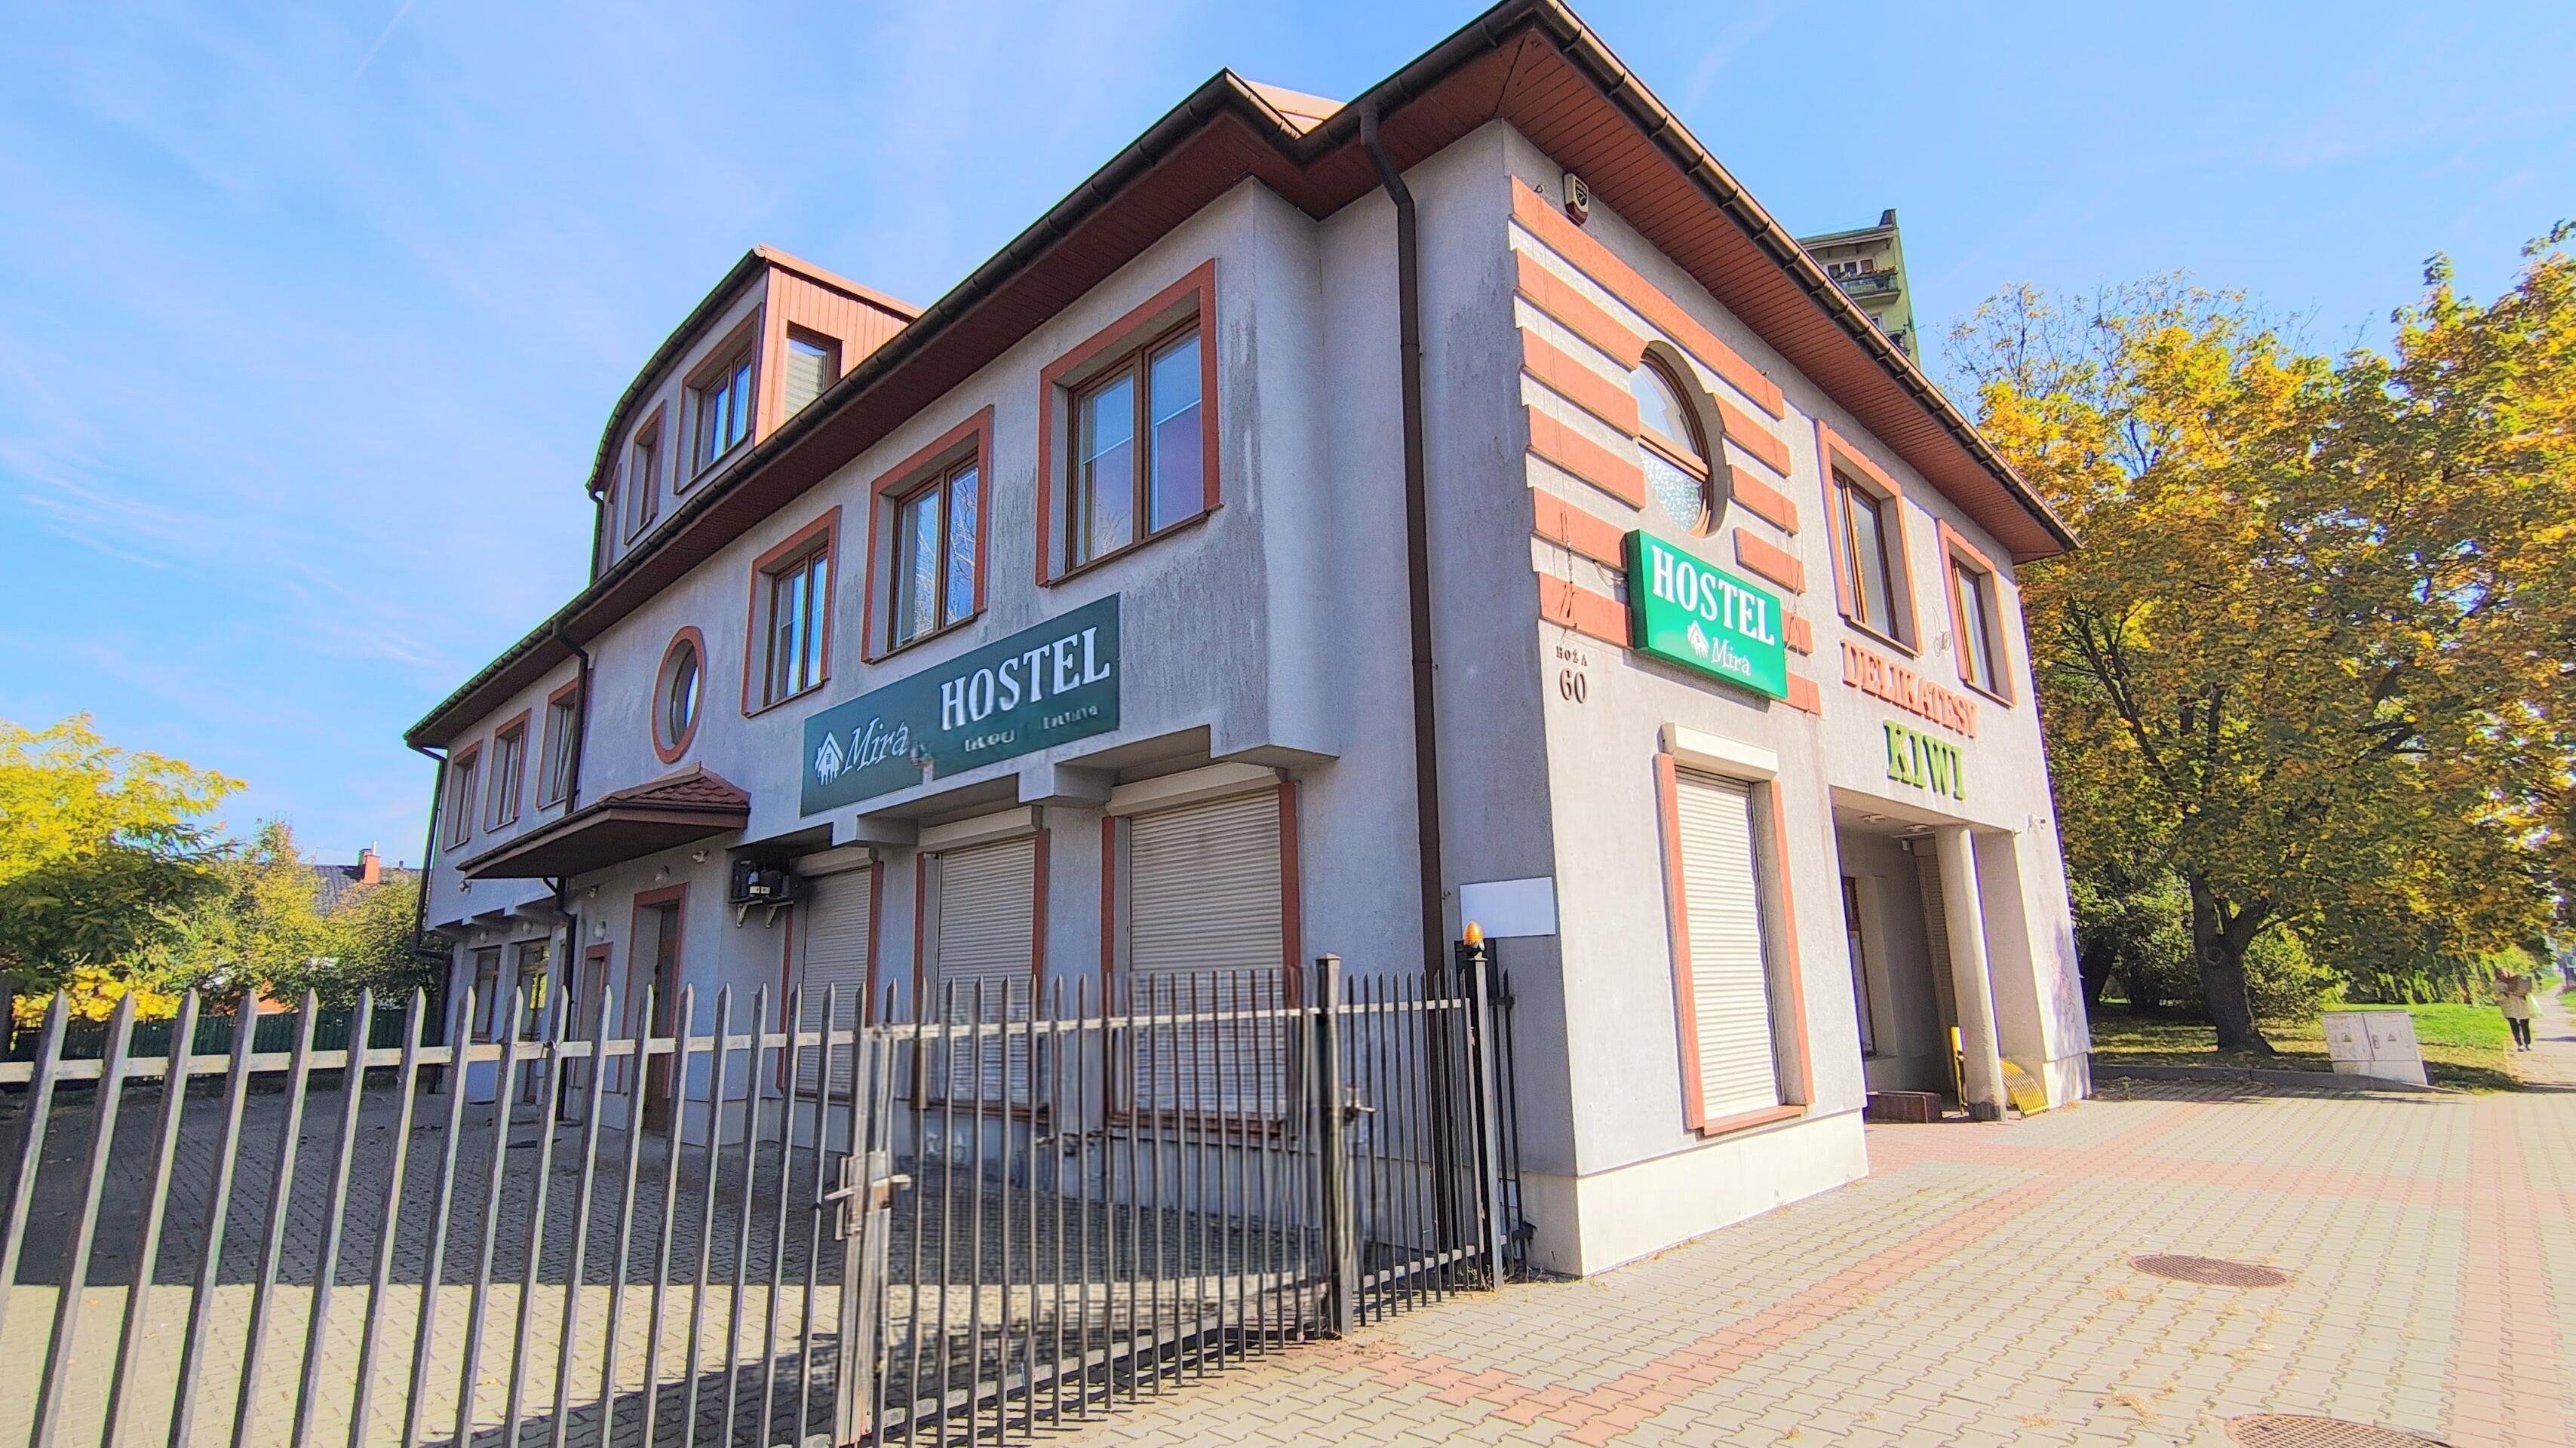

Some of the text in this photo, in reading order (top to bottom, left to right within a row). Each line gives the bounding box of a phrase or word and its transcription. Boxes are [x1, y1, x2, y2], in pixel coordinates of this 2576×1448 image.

[1651, 546, 1775, 646] HOSTEL
[841, 627, 1110, 775] Mira HOSTEL
[1560, 668, 1586, 704] 60
[1711, 637, 1752, 676] Mira
[1841, 639, 1979, 739] DELIKATESY
[1884, 719, 1967, 800] KIWI
